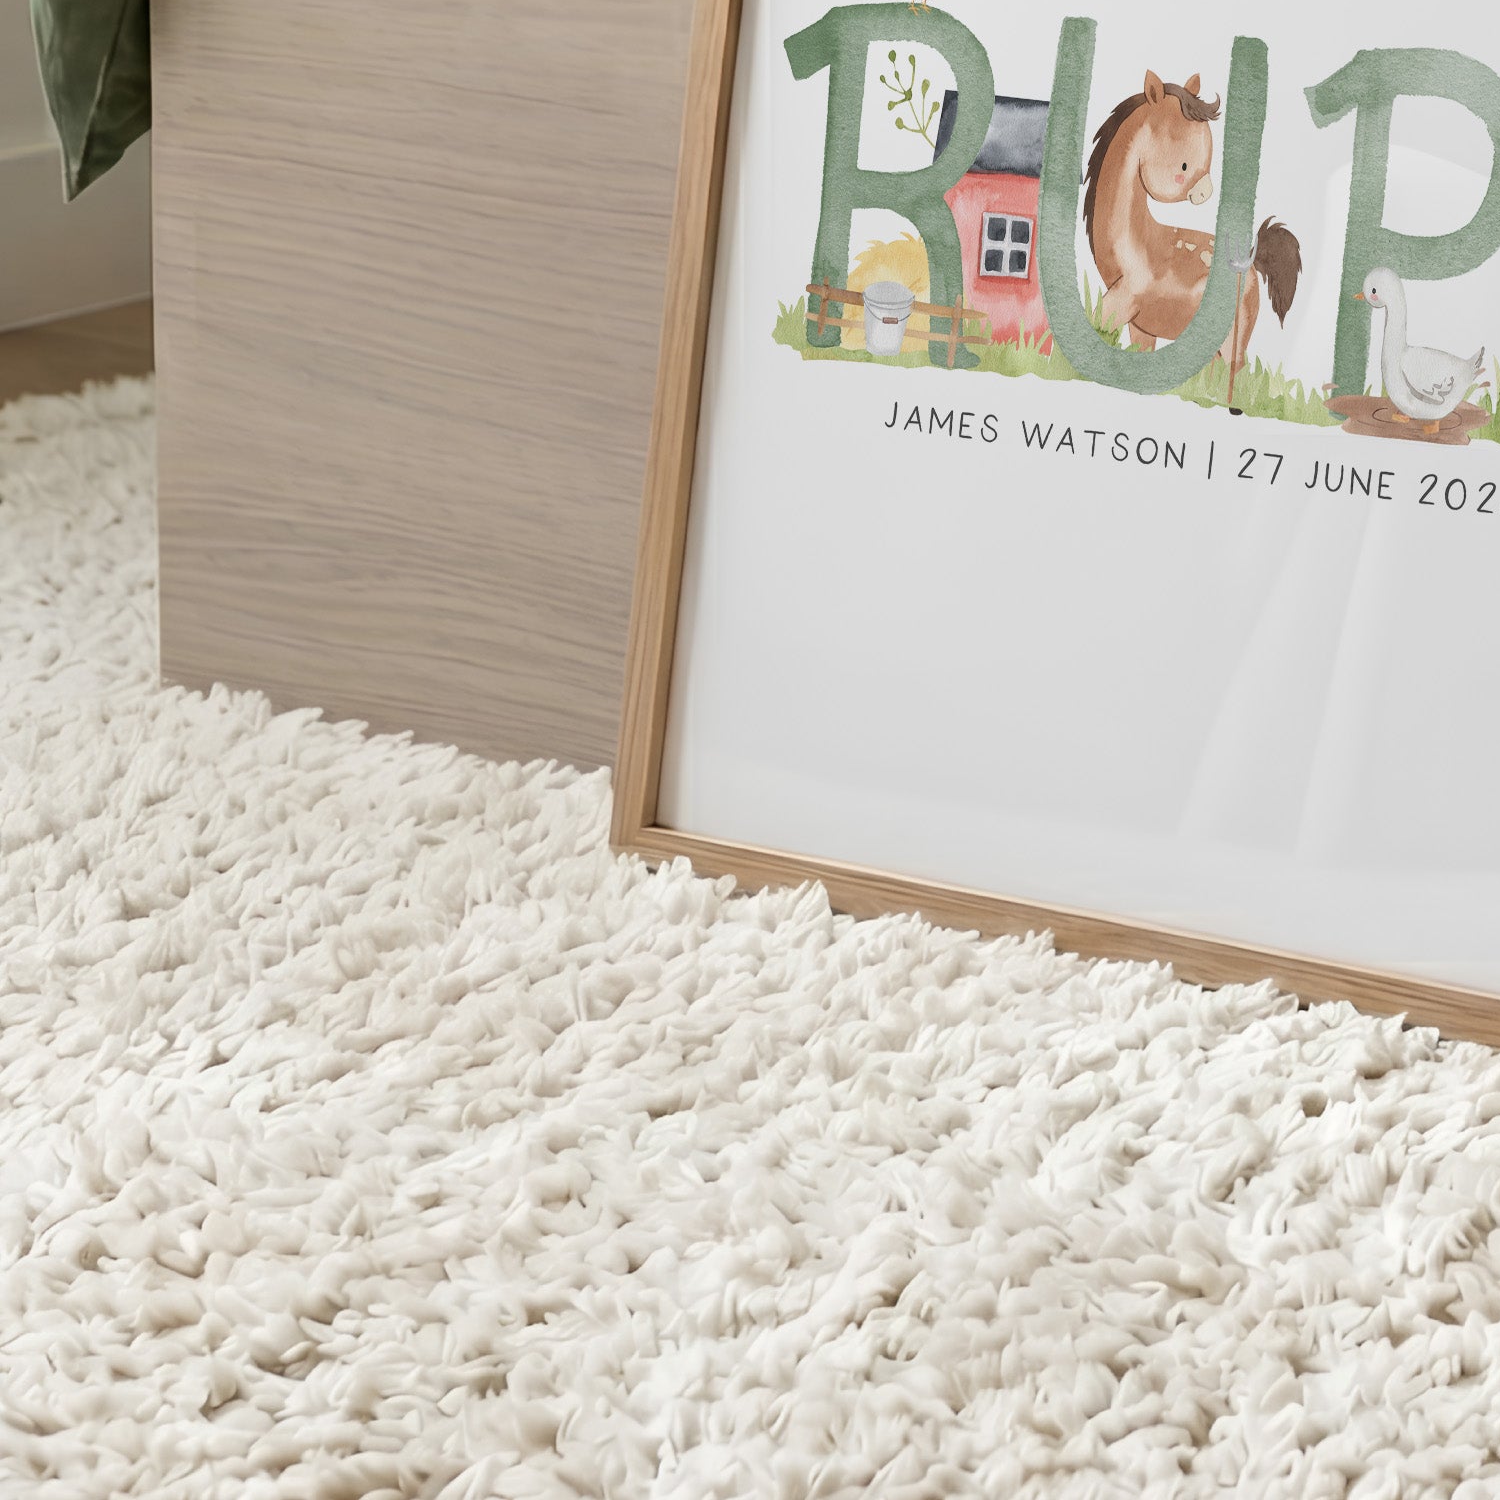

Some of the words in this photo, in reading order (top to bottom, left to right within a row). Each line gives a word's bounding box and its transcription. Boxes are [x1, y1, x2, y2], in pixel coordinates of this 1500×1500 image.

[884, 401, 999, 444] JAMES
[1021, 420, 1187, 470] WATSON
[1237, 447, 1285, 486] 27
[1304, 460, 1396, 501] JUNE
